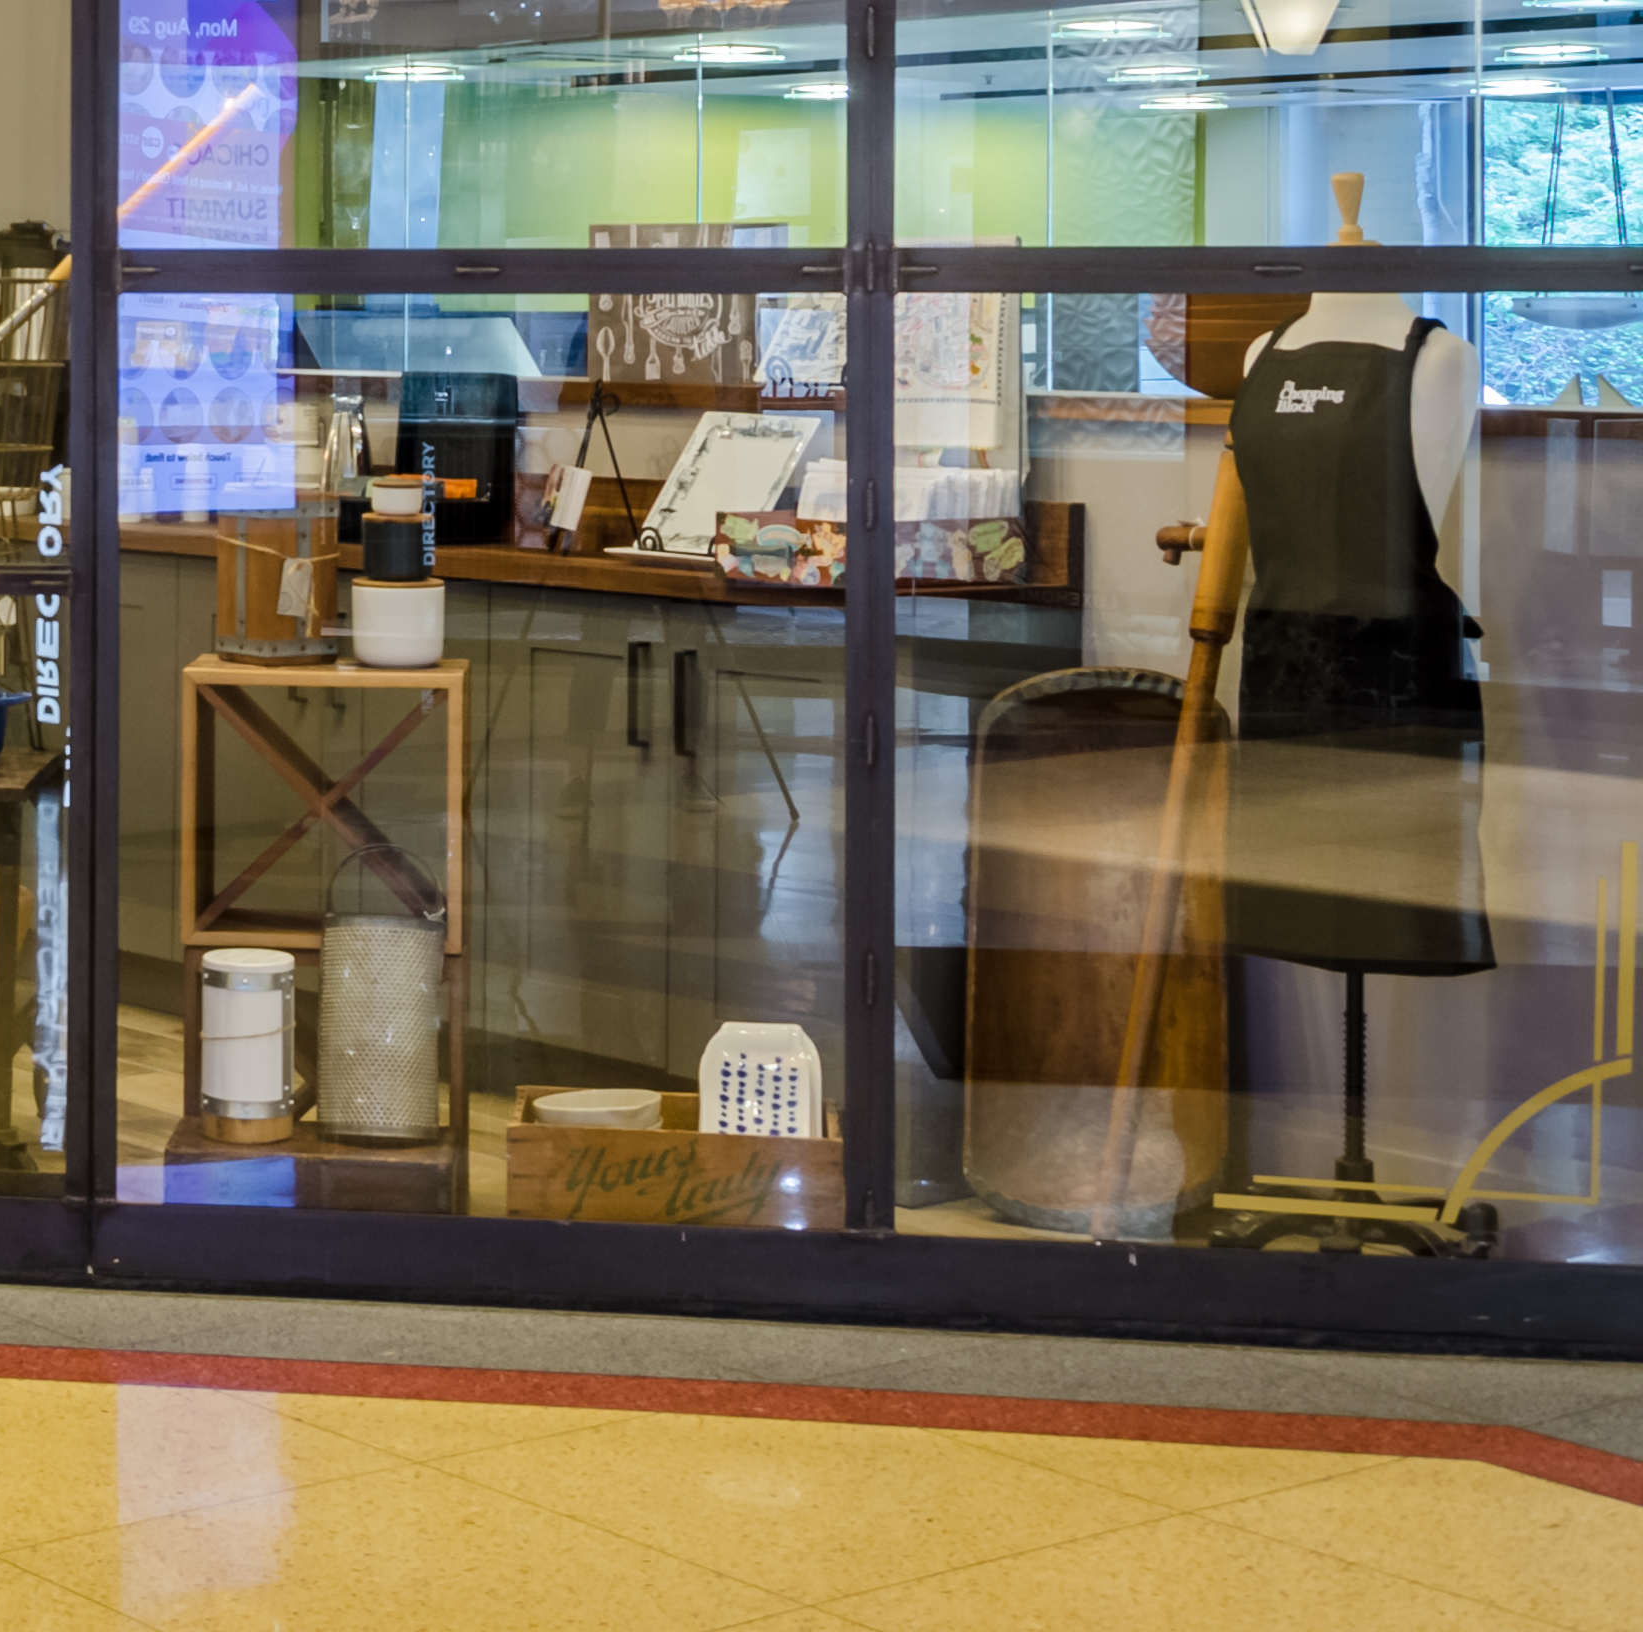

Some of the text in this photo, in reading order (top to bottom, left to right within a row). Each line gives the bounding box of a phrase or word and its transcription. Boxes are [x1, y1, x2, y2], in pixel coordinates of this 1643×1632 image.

[1279, 386, 1345, 404] Chopping
[422, 441, 434, 567] DIRECTORY
[565, 1139, 699, 1220] Yours
